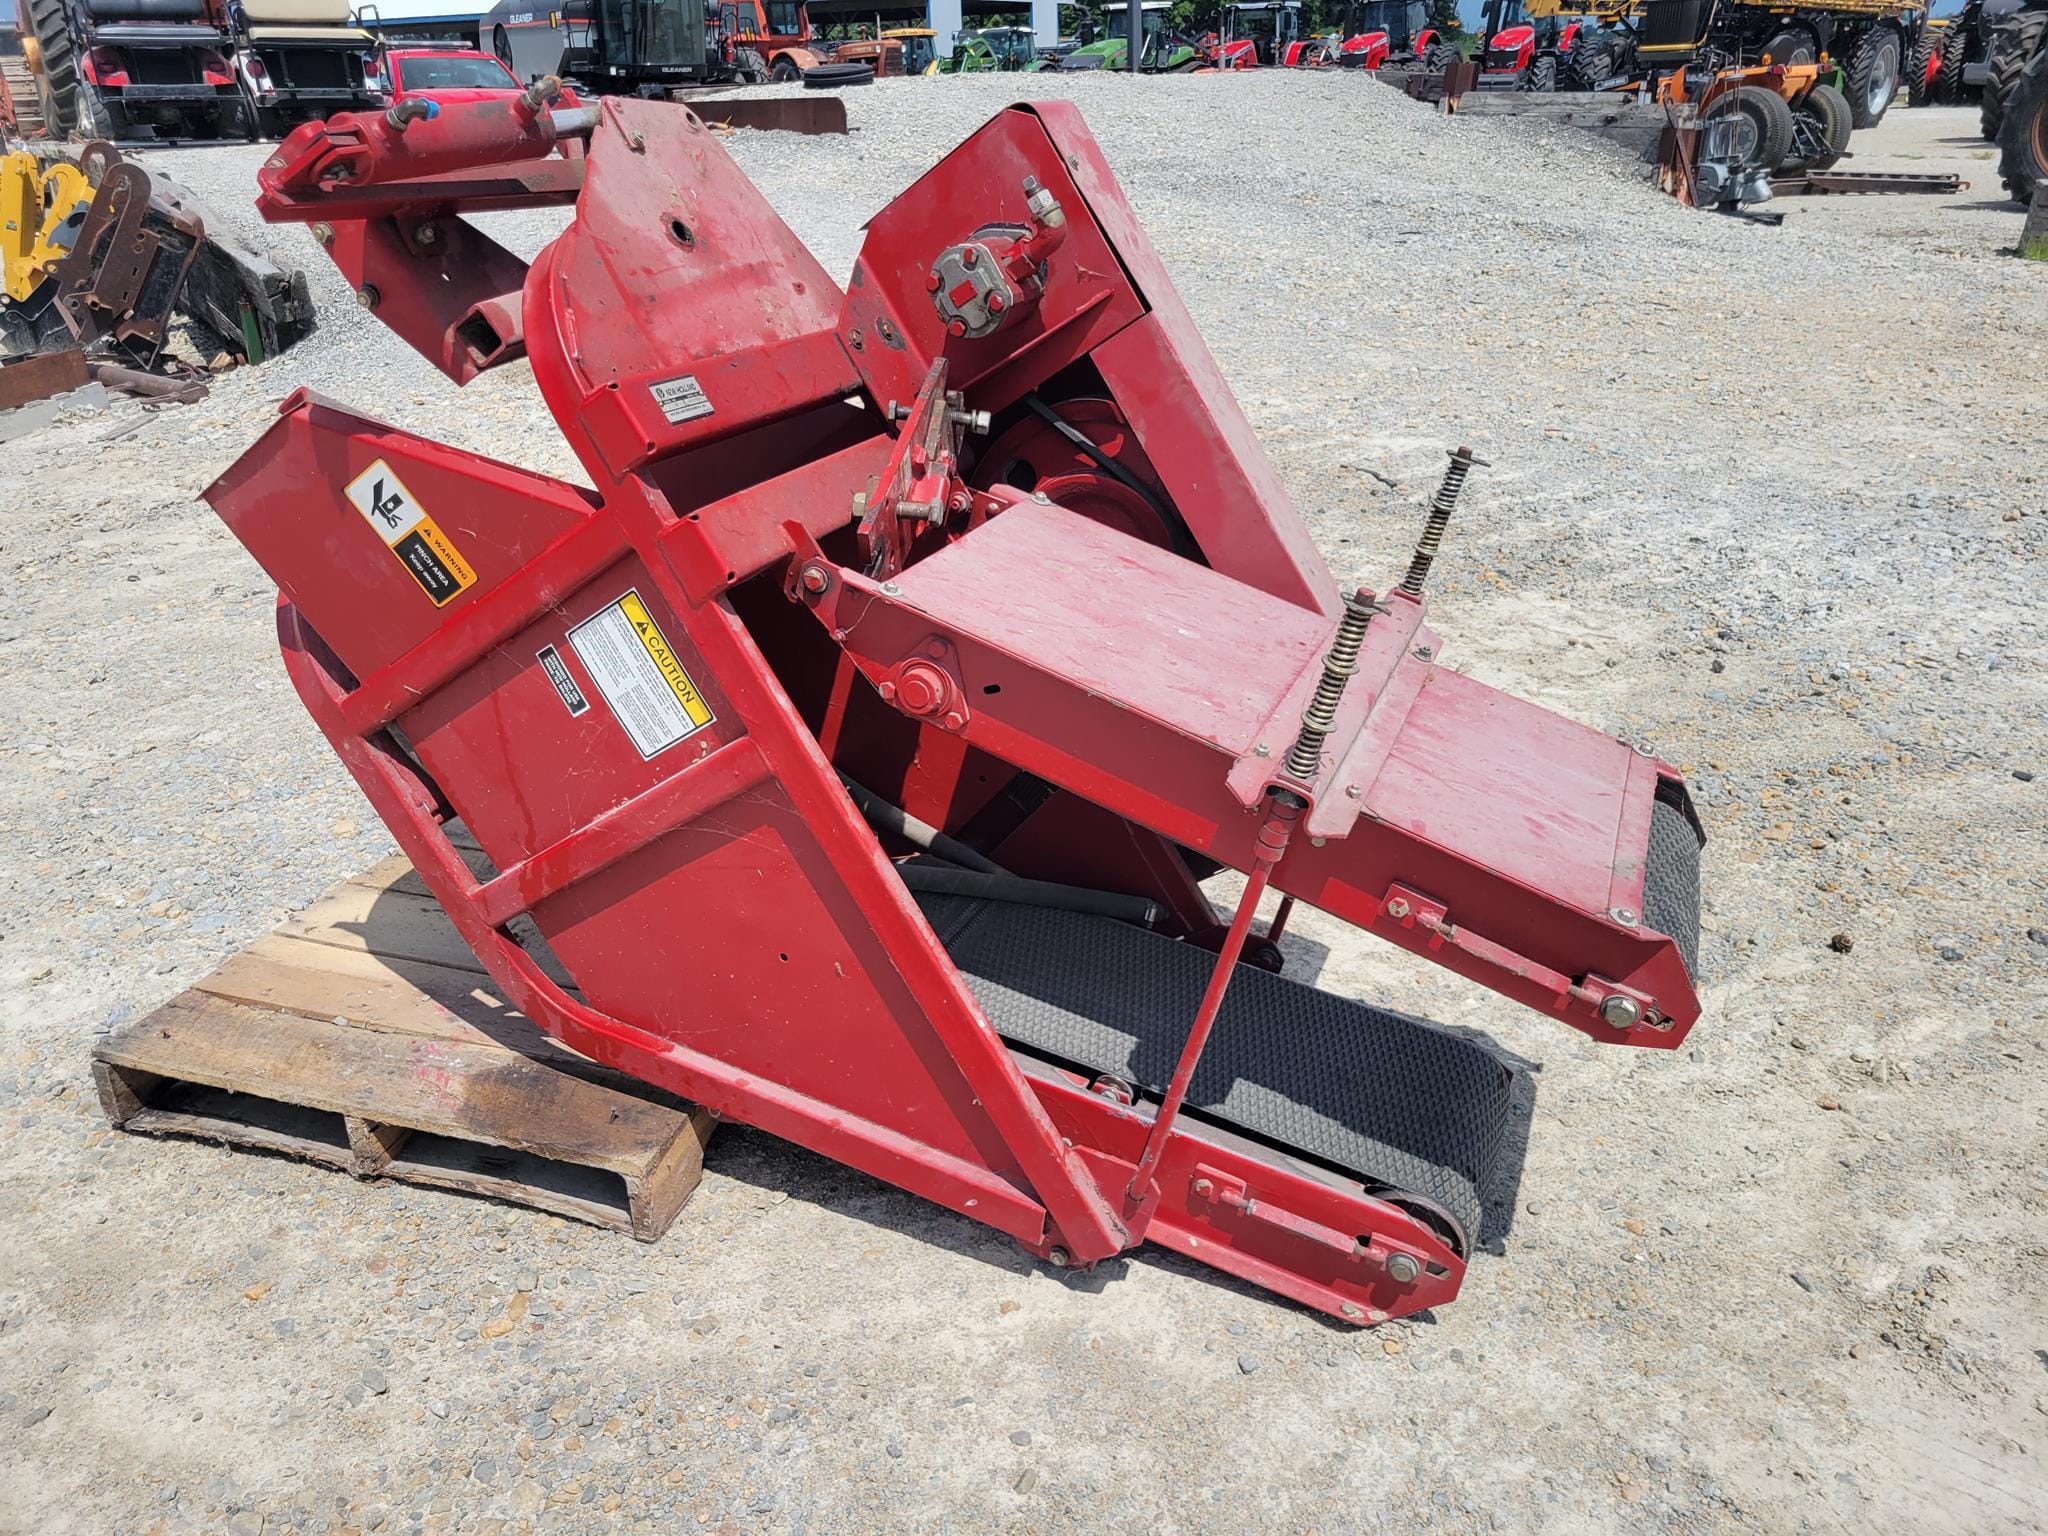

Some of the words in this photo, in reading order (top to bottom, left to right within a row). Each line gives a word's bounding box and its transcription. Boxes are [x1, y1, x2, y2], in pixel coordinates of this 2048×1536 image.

[509, 13, 533, 24] GLEANER
[676, 382, 696, 393] HOLLAND
[408, 553, 424, 571] Keep
[422, 570, 437, 588] away
[414, 543, 433, 565] PINCH
[431, 564, 449, 586] AREA
[434, 540, 467, 578] WARNING
[648, 635, 695, 703] CAUTION
